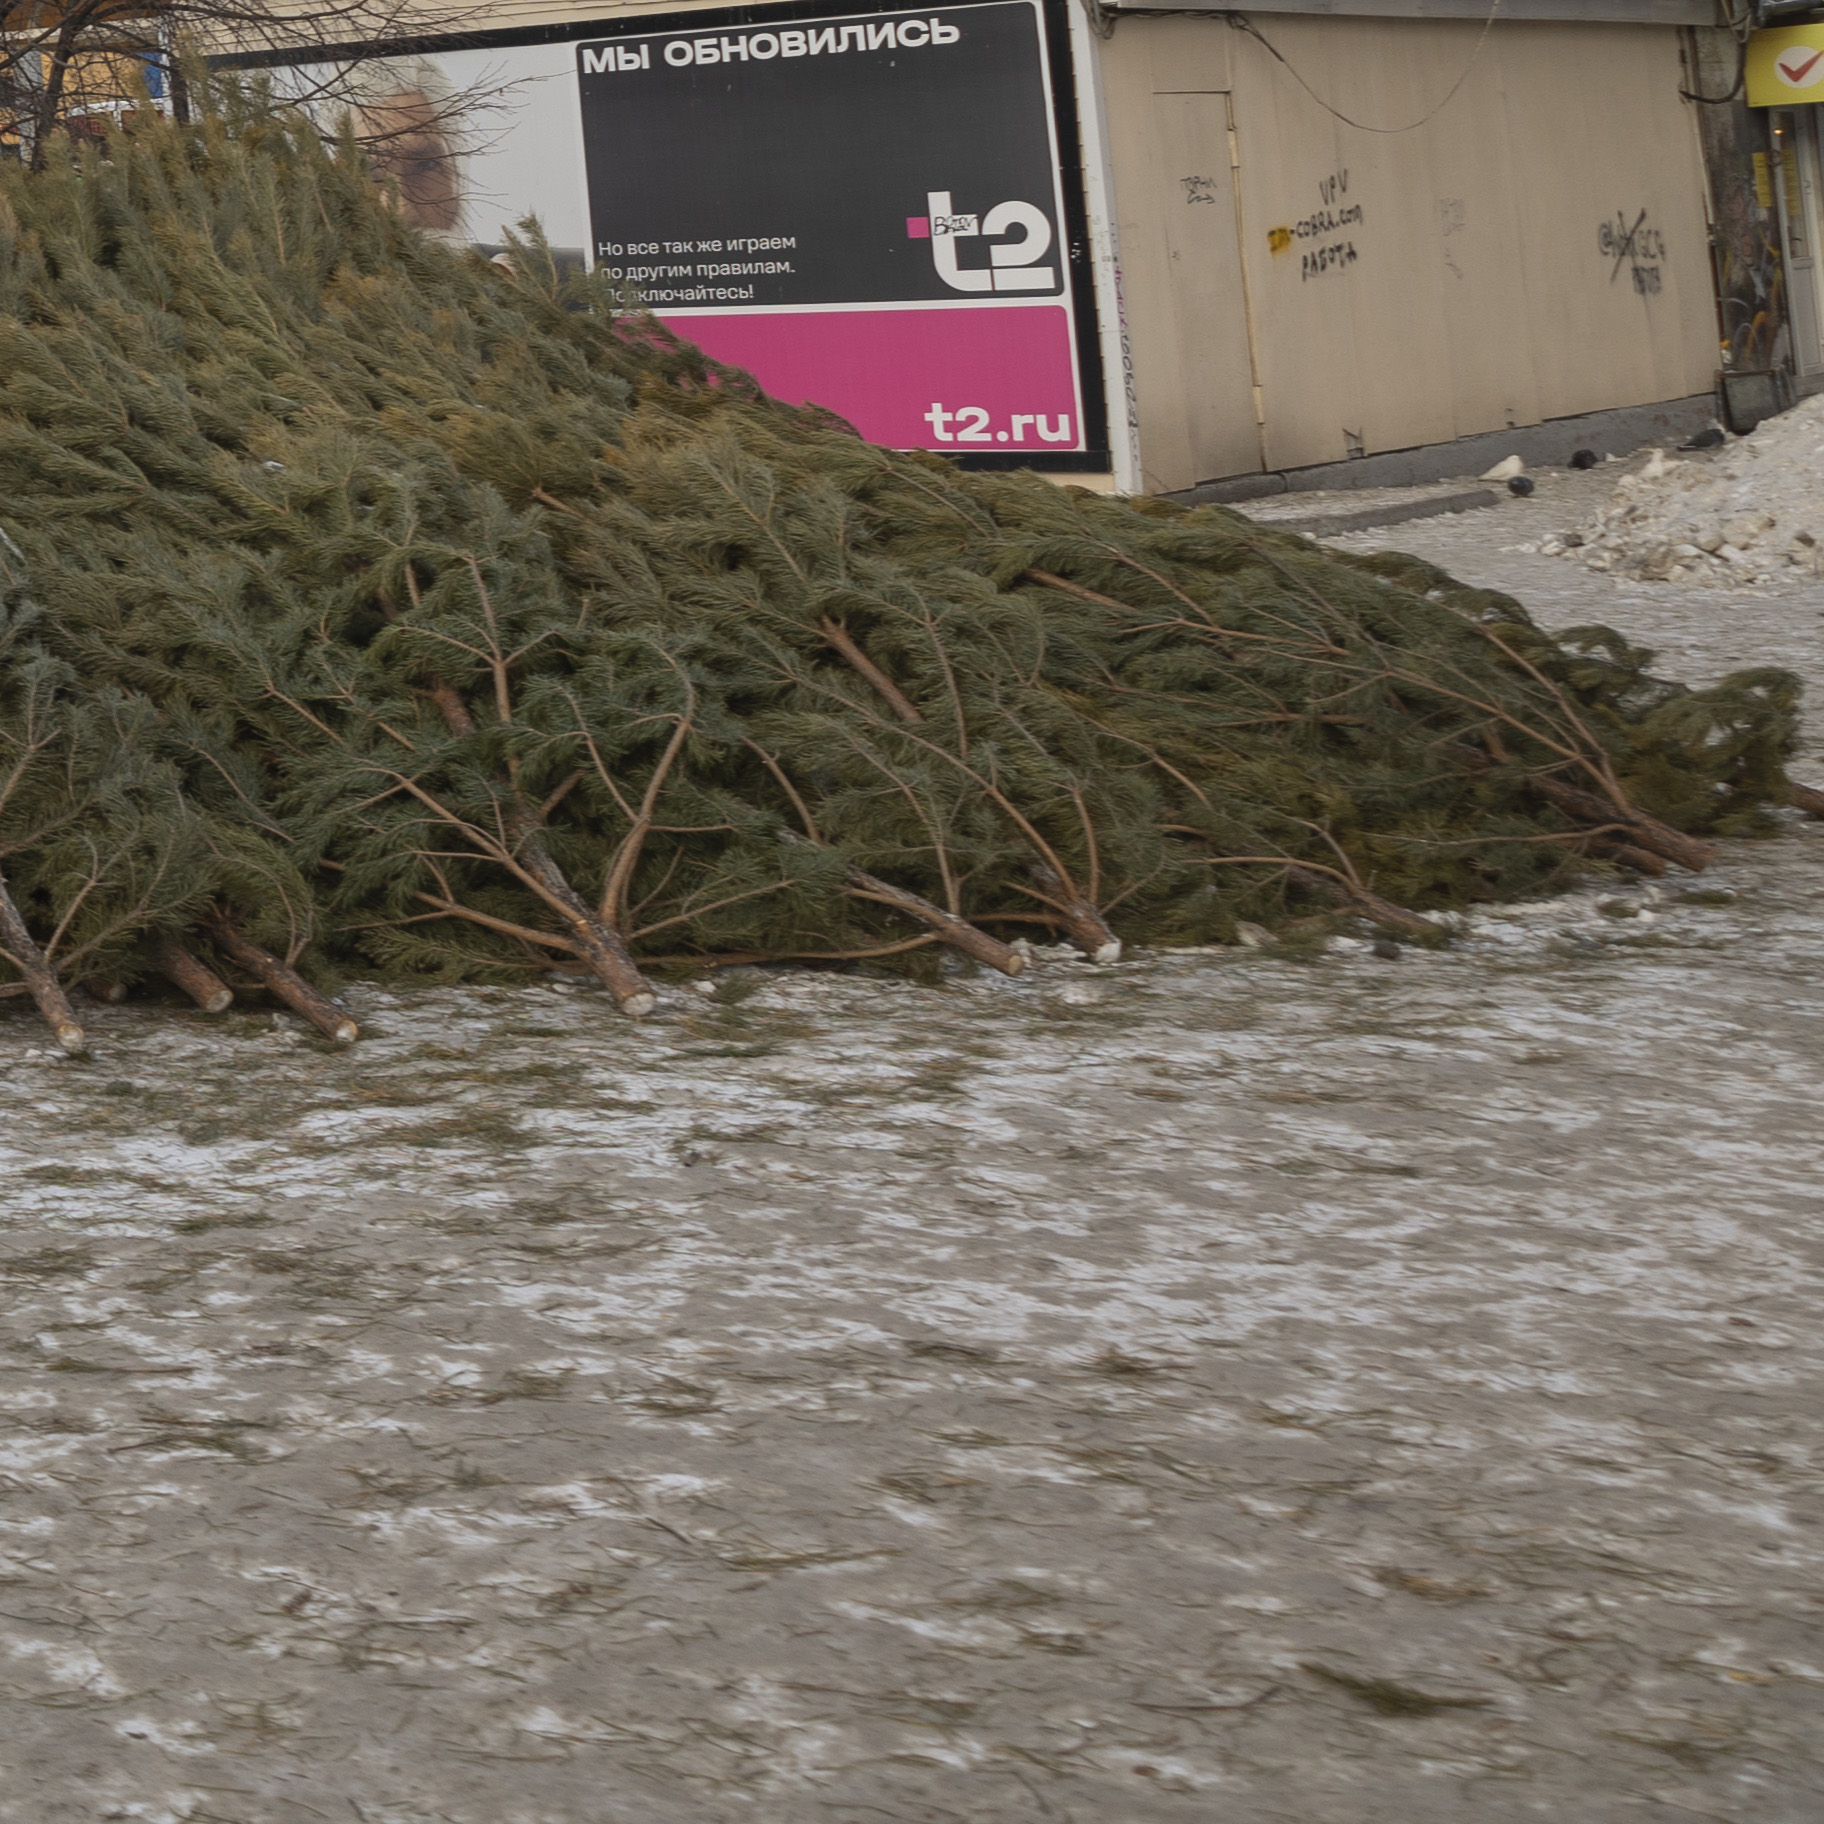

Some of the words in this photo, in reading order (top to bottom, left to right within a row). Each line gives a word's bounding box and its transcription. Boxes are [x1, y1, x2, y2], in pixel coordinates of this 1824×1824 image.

[582, 45, 651, 76] МЫ
[663, 17, 961, 70] ОБНОВИЛИСЬ
[597, 241, 624, 257] Но
[627, 241, 660, 256] все
[663, 239, 694, 255] так
[696, 239, 723, 254] же
[726, 235, 797, 256] играем
[908, 190, 1057, 293] t2
[600, 266, 623, 281] по
[625, 264, 692, 283] другим
[696, 260, 797, 281] правилам.
[606, 283, 755, 303] Поключайтесь!
[923, 401, 1072, 446] t2.ru
